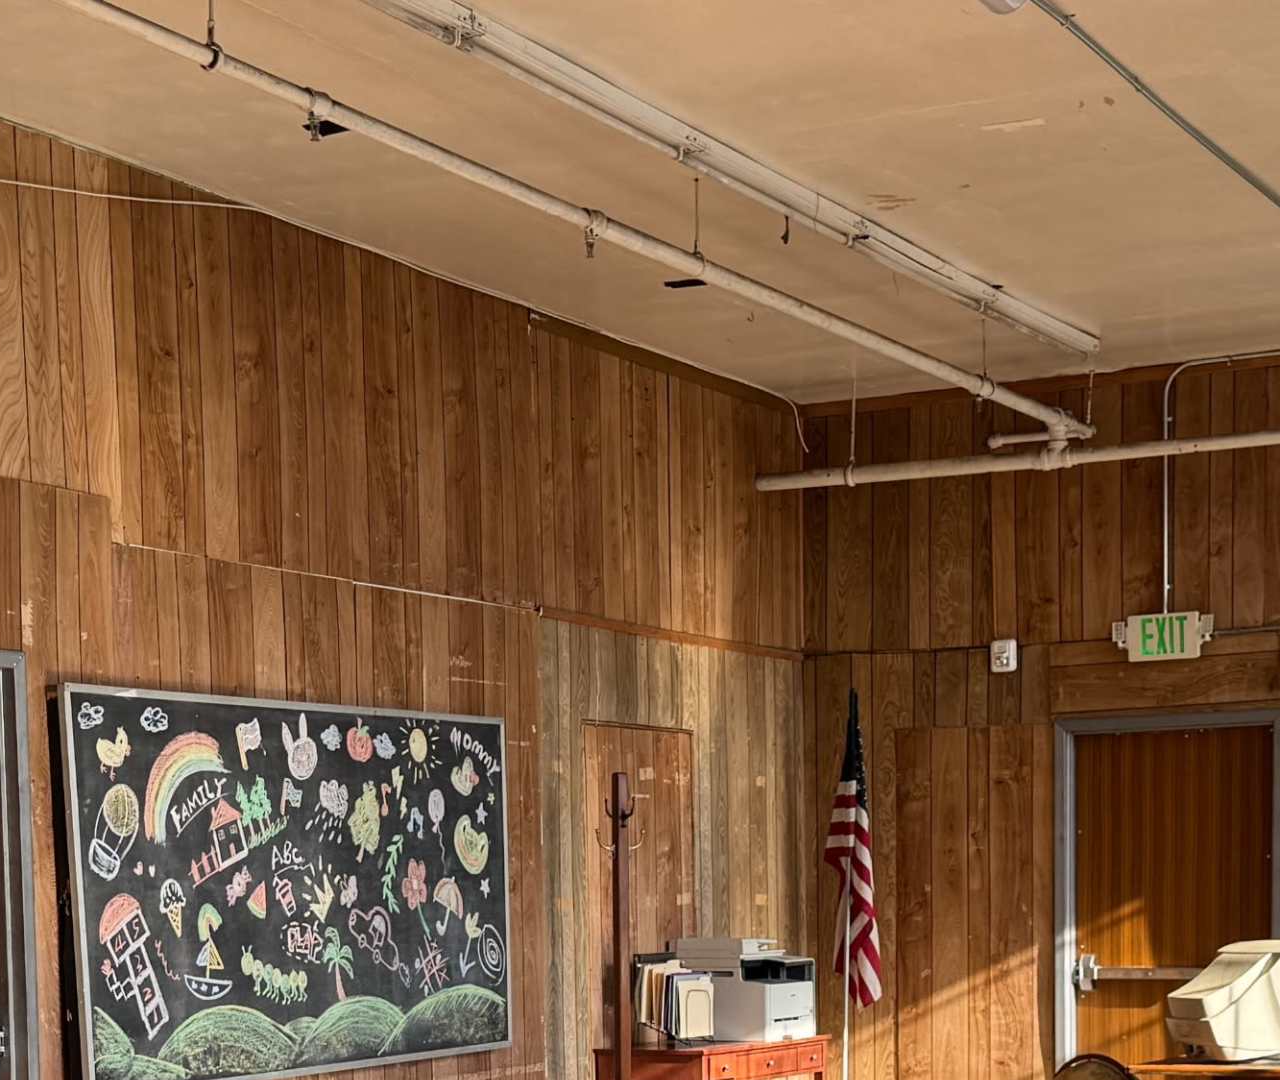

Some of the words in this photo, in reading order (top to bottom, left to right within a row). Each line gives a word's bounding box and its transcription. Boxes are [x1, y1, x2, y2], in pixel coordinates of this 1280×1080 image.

[1141, 615, 1188, 656] EXIT
[170, 778, 227, 836] FAMILY
[272, 840, 305, 870] ABC
[115, 933, 126, 952] 4
[132, 919, 140, 940] 5
[134, 954, 143, 973] 3
[143, 987, 153, 1001] 2
